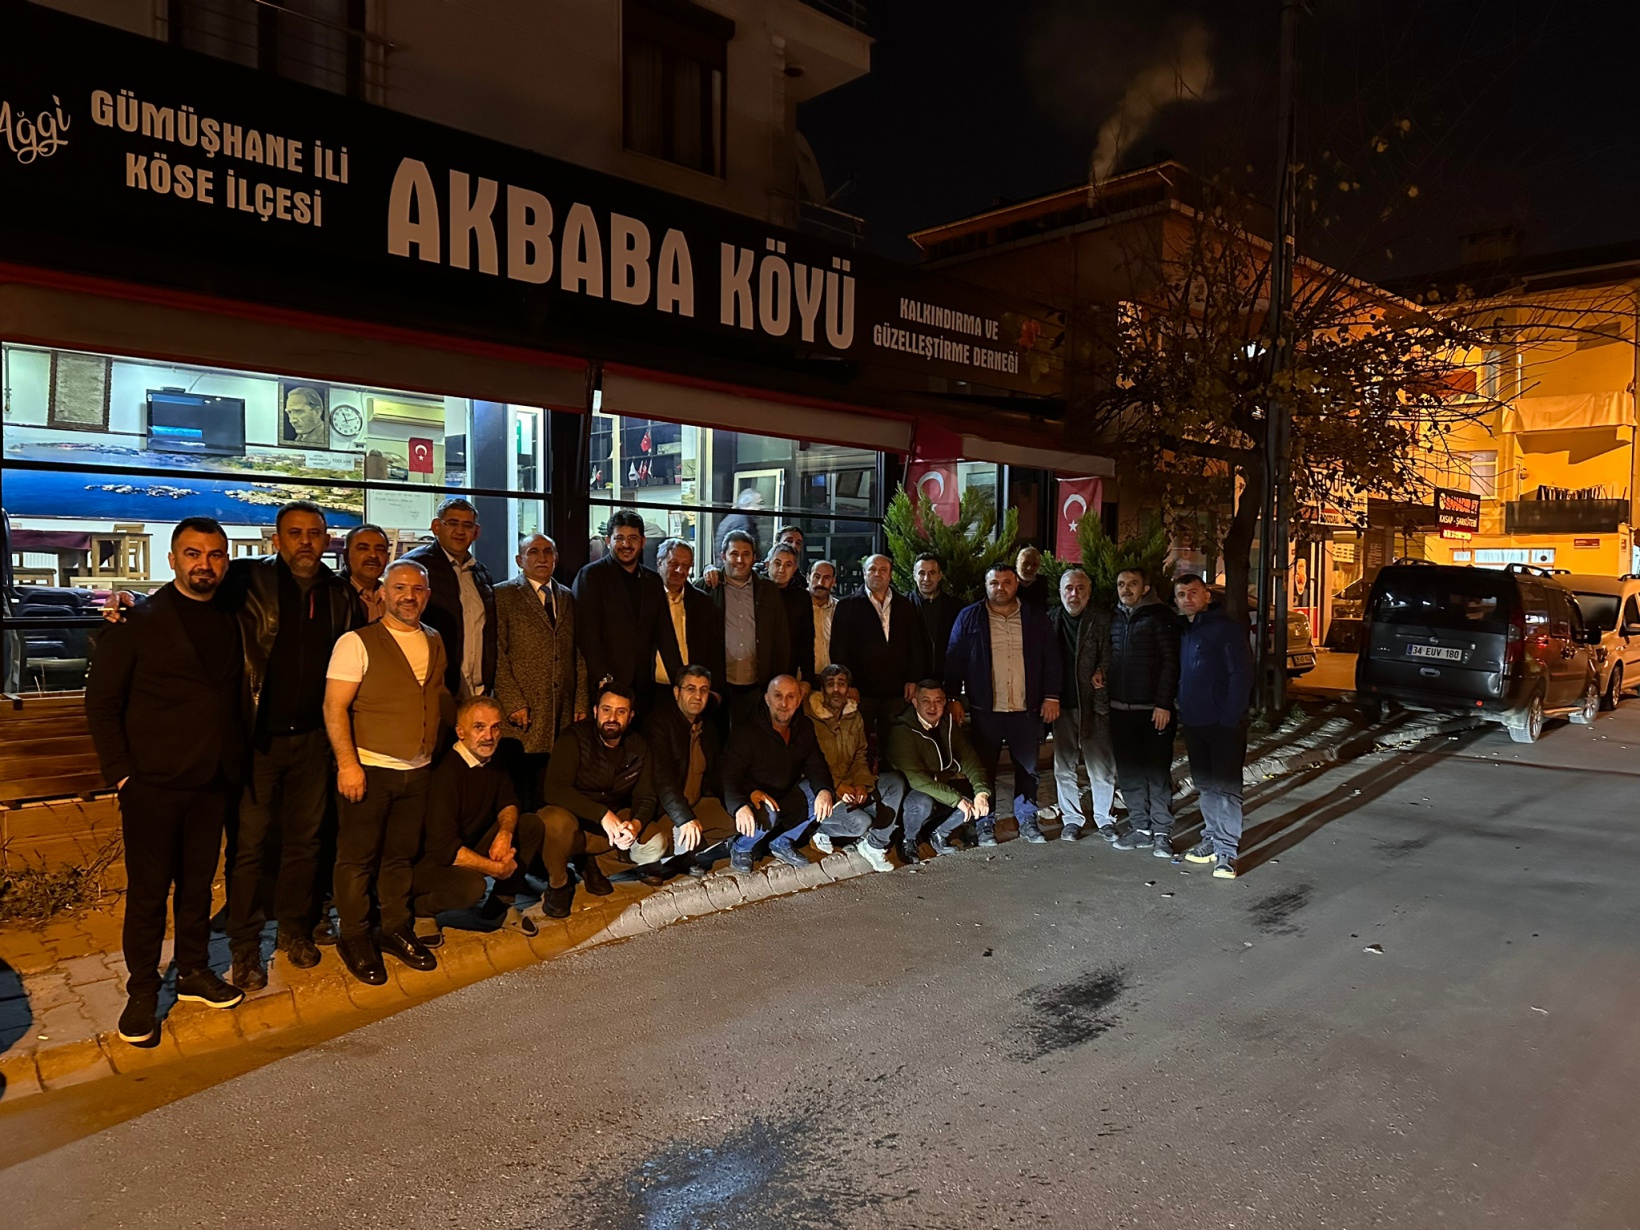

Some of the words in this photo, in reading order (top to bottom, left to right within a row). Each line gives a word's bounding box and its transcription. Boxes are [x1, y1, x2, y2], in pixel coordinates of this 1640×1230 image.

[91, 88, 303, 169] GÜMÜŞHANE
[314, 140, 349, 184] İLİ
[126, 151, 214, 205] KÖSE
[226, 168, 322, 228] İLÇESİ
[387, 157, 695, 318] AKBABA
[720, 237, 855, 350] KÖYÜ
[899, 297, 982, 338] KALKINDIRMA
[985, 318, 999, 341] VE
[873, 322, 970, 365] GÜZELLEŞTİRME
[973, 346, 1019, 374] DERNEĞİ
[1439, 514, 1453, 524] KASAP
[1412, 646, 1423, 655] 34
[1425, 647, 1442, 657] EUV
[1445, 649, 1460, 659] 180
